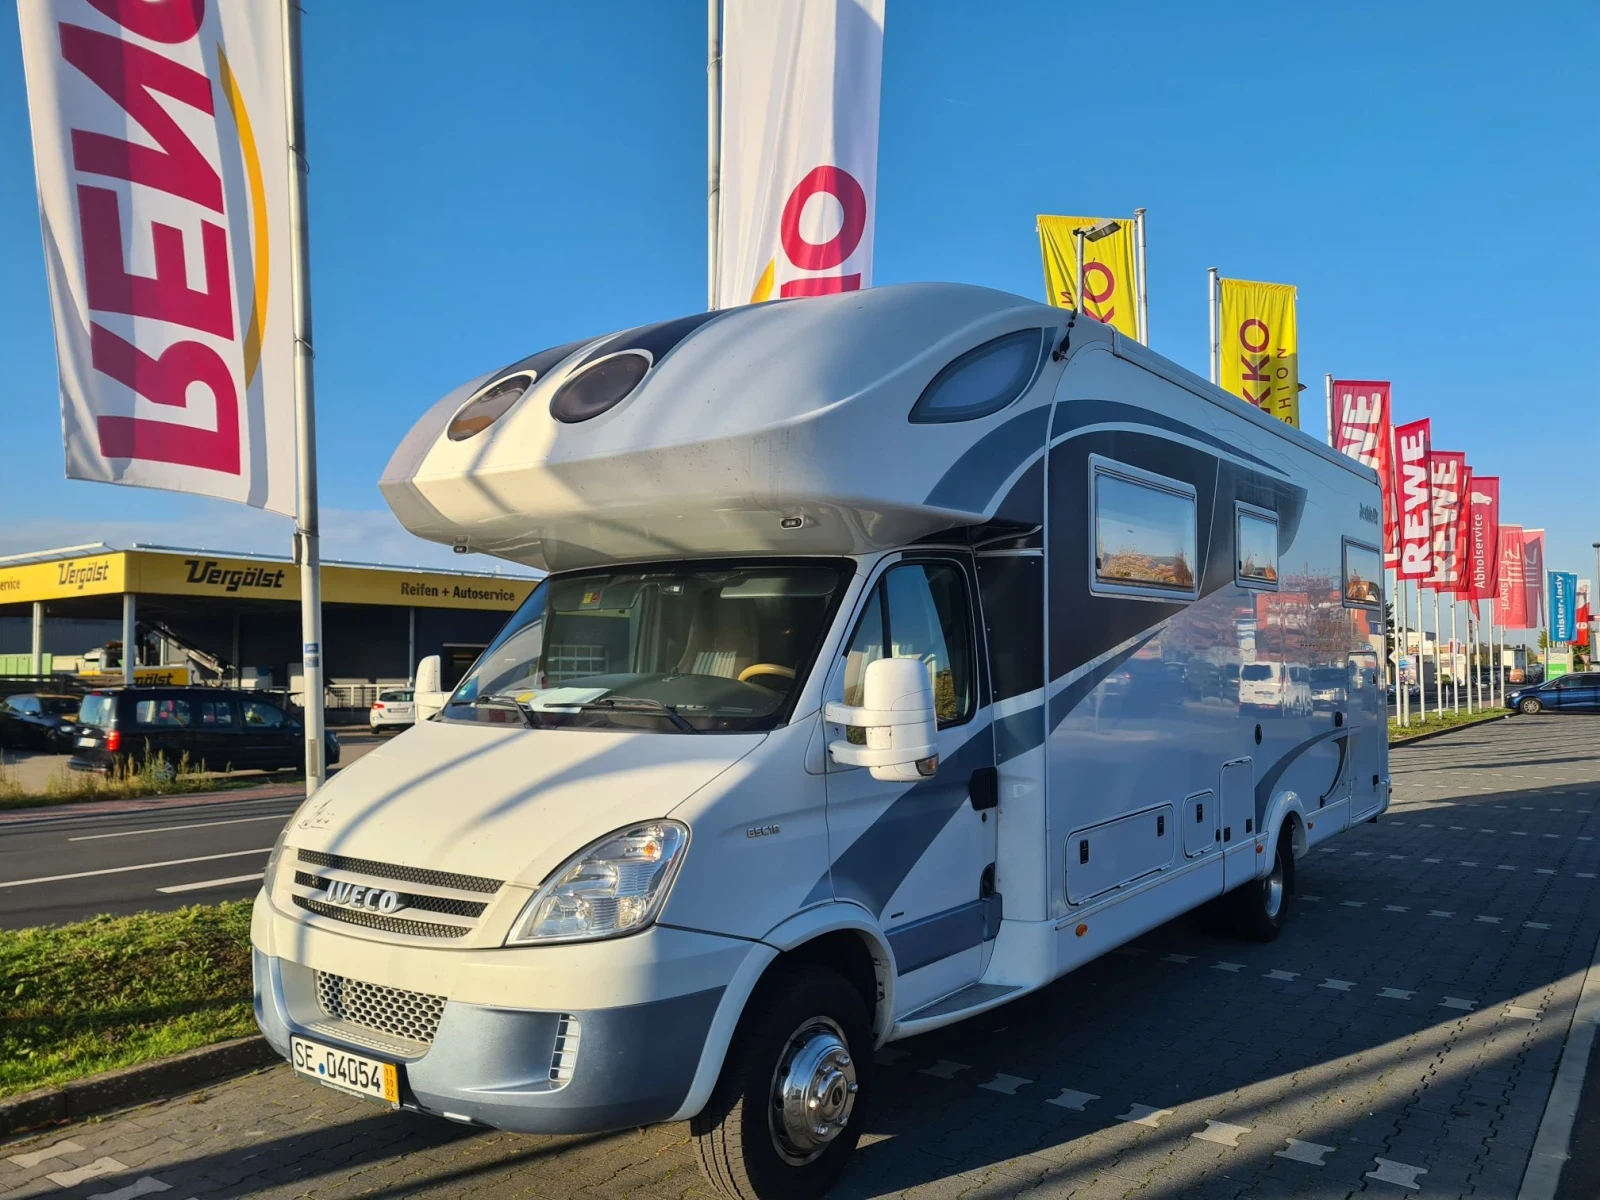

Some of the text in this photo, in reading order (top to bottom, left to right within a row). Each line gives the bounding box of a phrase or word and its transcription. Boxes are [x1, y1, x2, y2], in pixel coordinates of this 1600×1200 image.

[1401, 429, 1432, 574] REWE
[1423, 460, 1458, 582] REWE
[1473, 513, 1486, 589] Abholservice
[58, 561, 109, 590] Vergölst
[184, 559, 285, 592] Vergölst
[401, 582, 438, 597] Reifen
[453, 585, 515, 601] Autoservice
[326, 880, 400, 914] IVECO
[295, 1041, 316, 1073] SE
[326, 1051, 381, 1093] 04054
[386, 1088, 395, 1098] 22
